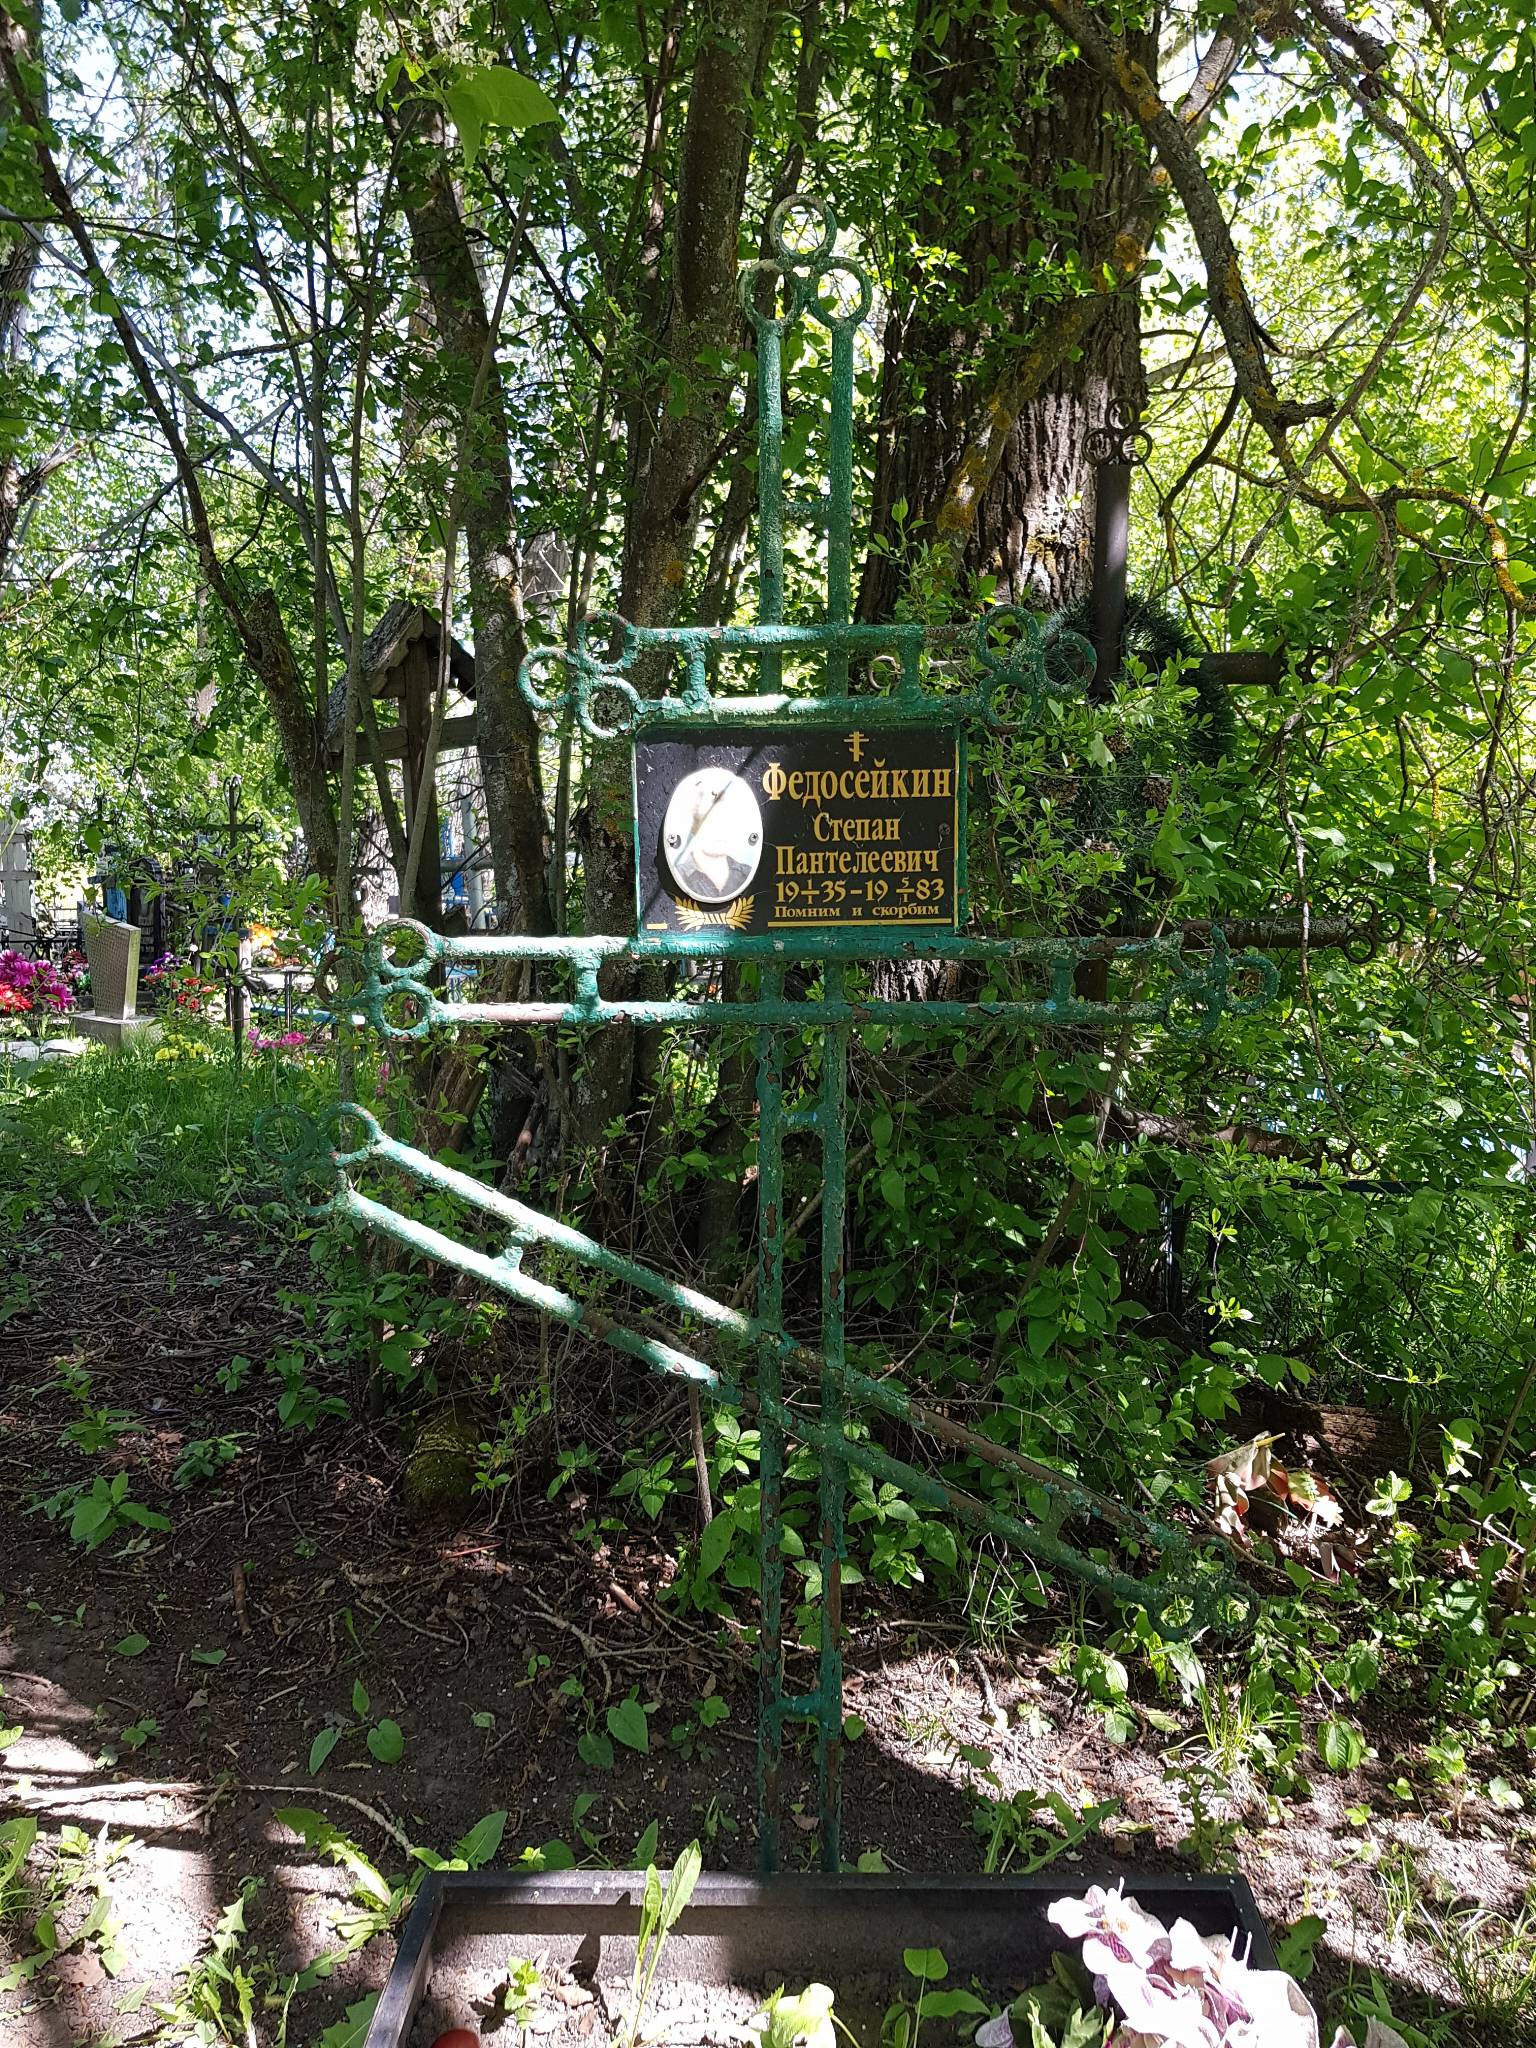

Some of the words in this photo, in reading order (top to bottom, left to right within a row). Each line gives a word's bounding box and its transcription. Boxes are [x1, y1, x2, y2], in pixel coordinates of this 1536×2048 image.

[762, 758, 952, 809] Федосейкин
[813, 812, 901, 842] Степан
[775, 846, 939, 875] Пантелеевич
[774, 906, 840, 918] Помним
[851, 907, 863, 916] и
[872, 902, 939, 919] скорбим
